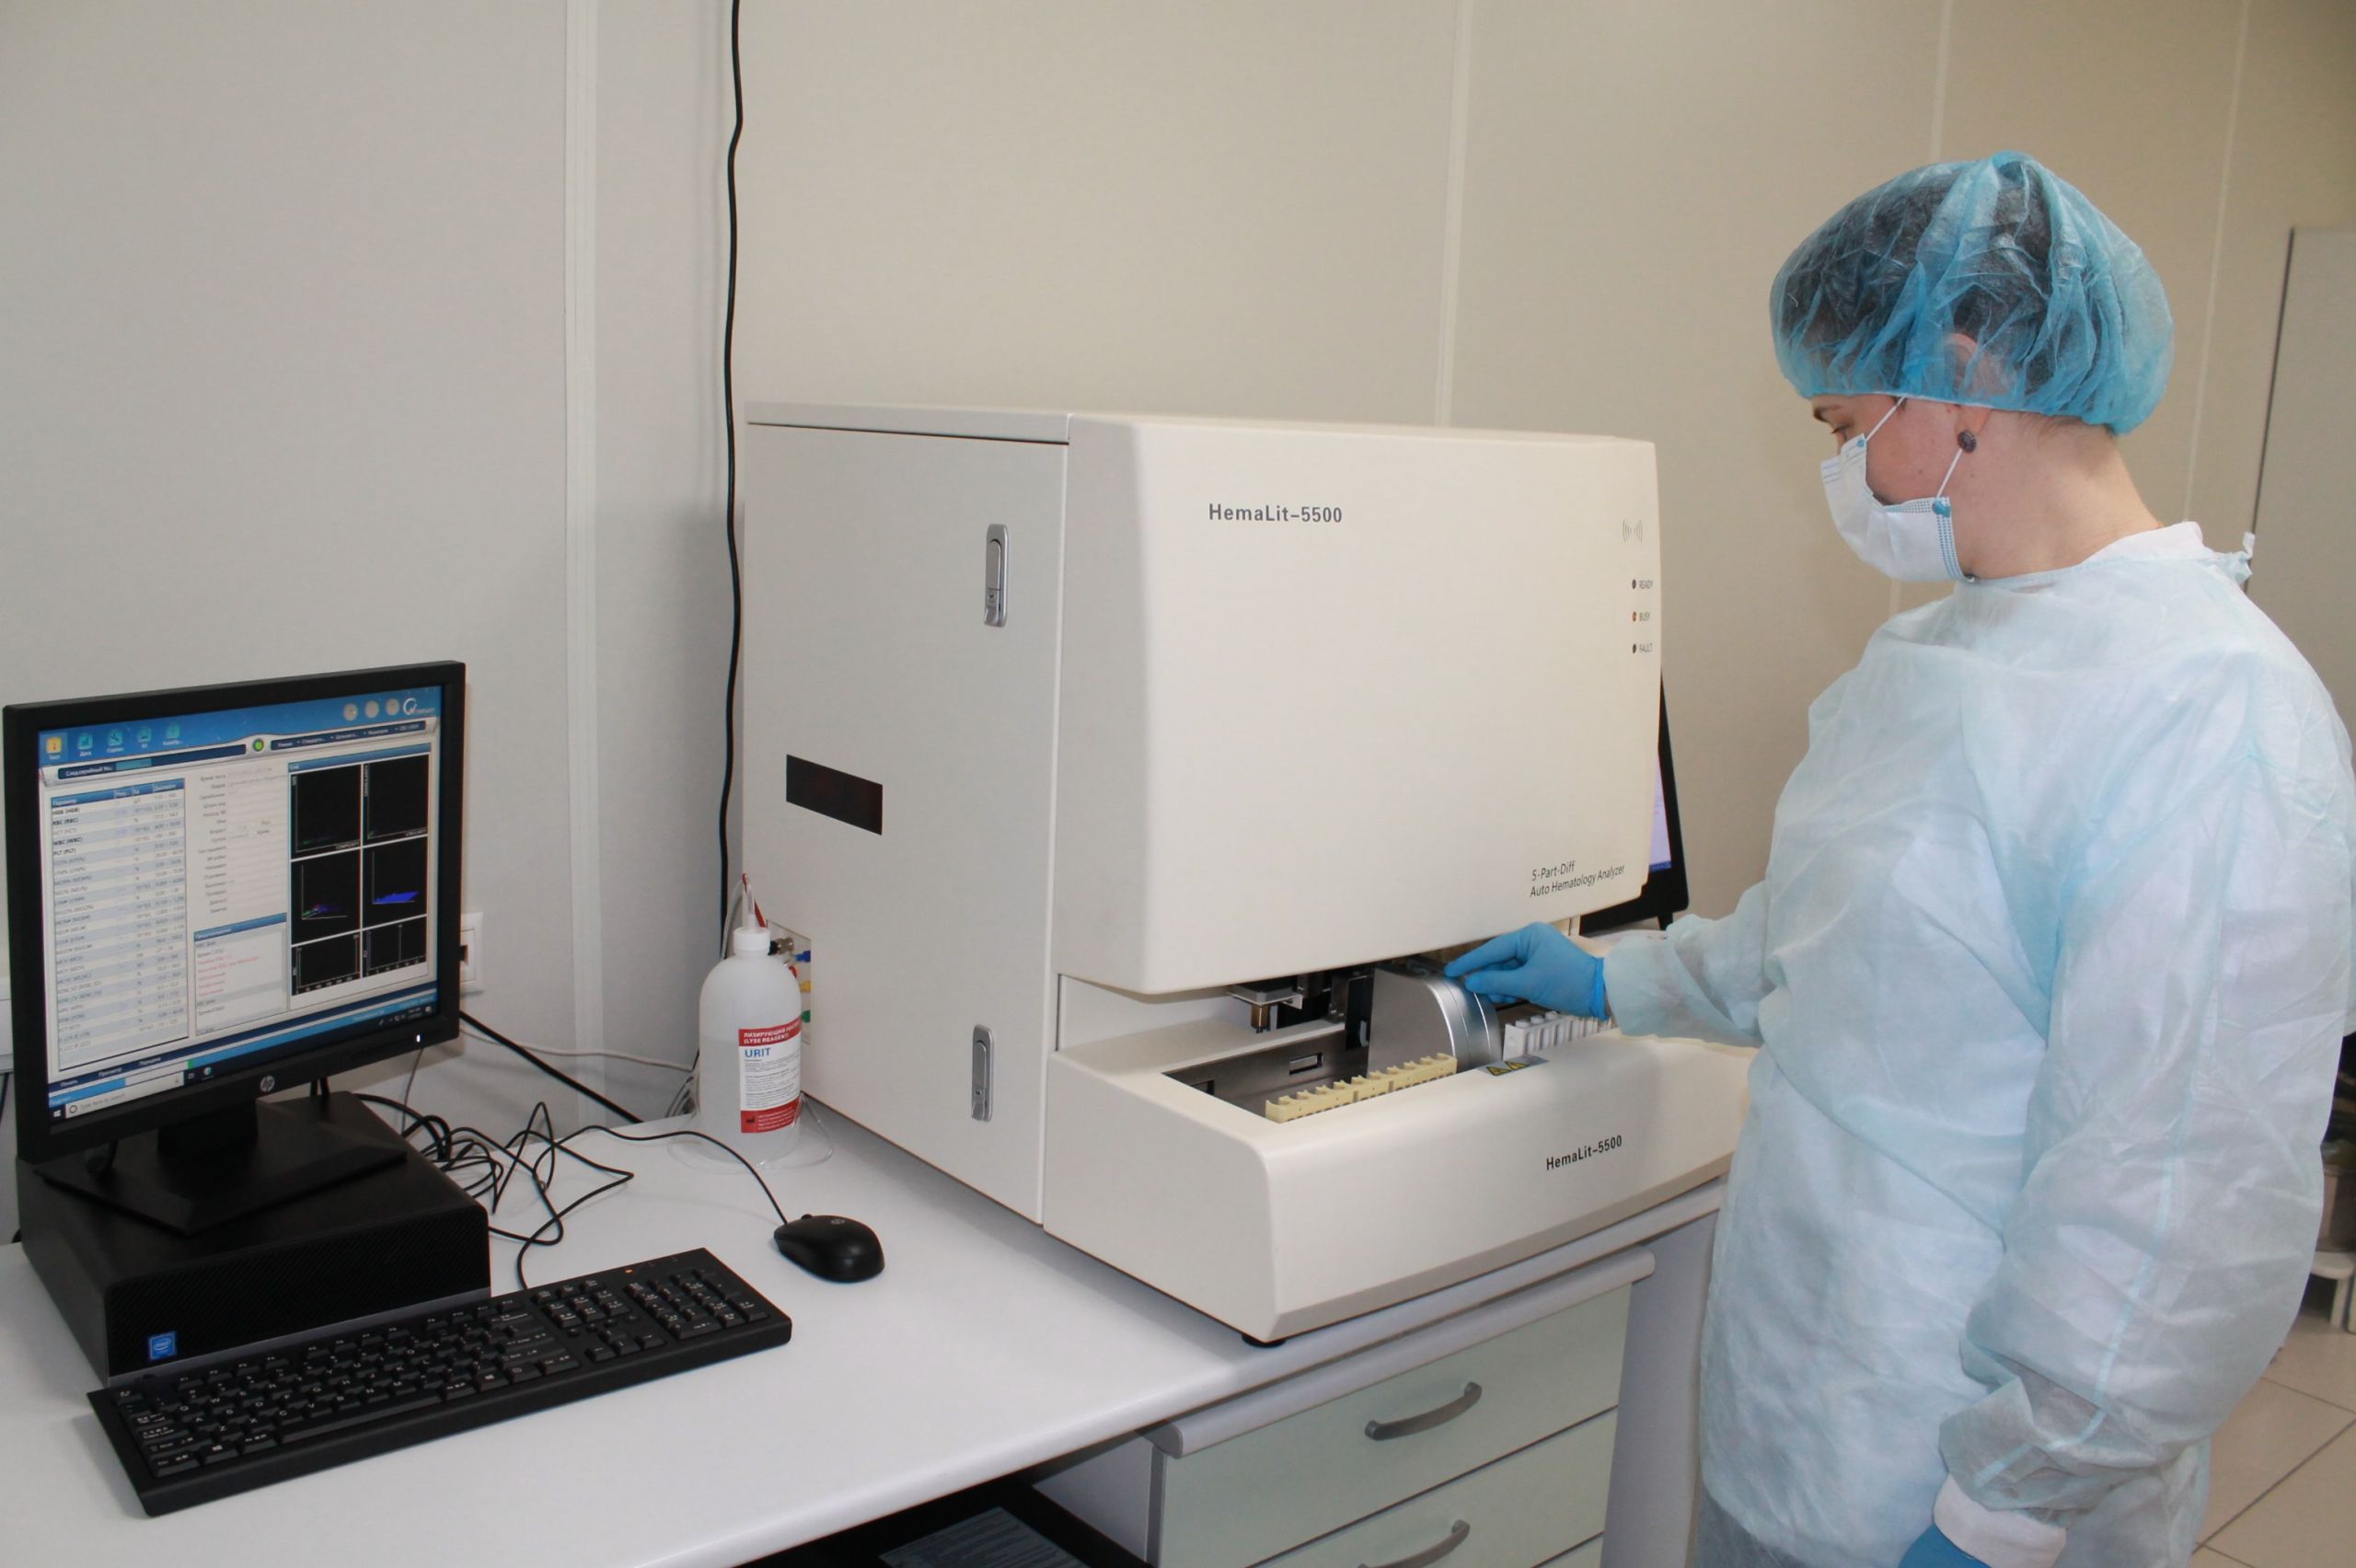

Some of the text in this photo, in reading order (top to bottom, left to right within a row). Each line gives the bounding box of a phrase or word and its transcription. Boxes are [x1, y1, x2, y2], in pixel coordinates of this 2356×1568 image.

[1208, 503, 1343, 523] HemaLit-5500
[1530, 865, 1625, 898] Auto Hematology Analyzer
[1531, 860, 1576, 882] 5-Part-Diff
[745, 1047, 771, 1058] URIT
[1546, 1135, 1623, 1171] HemaLit-5500
